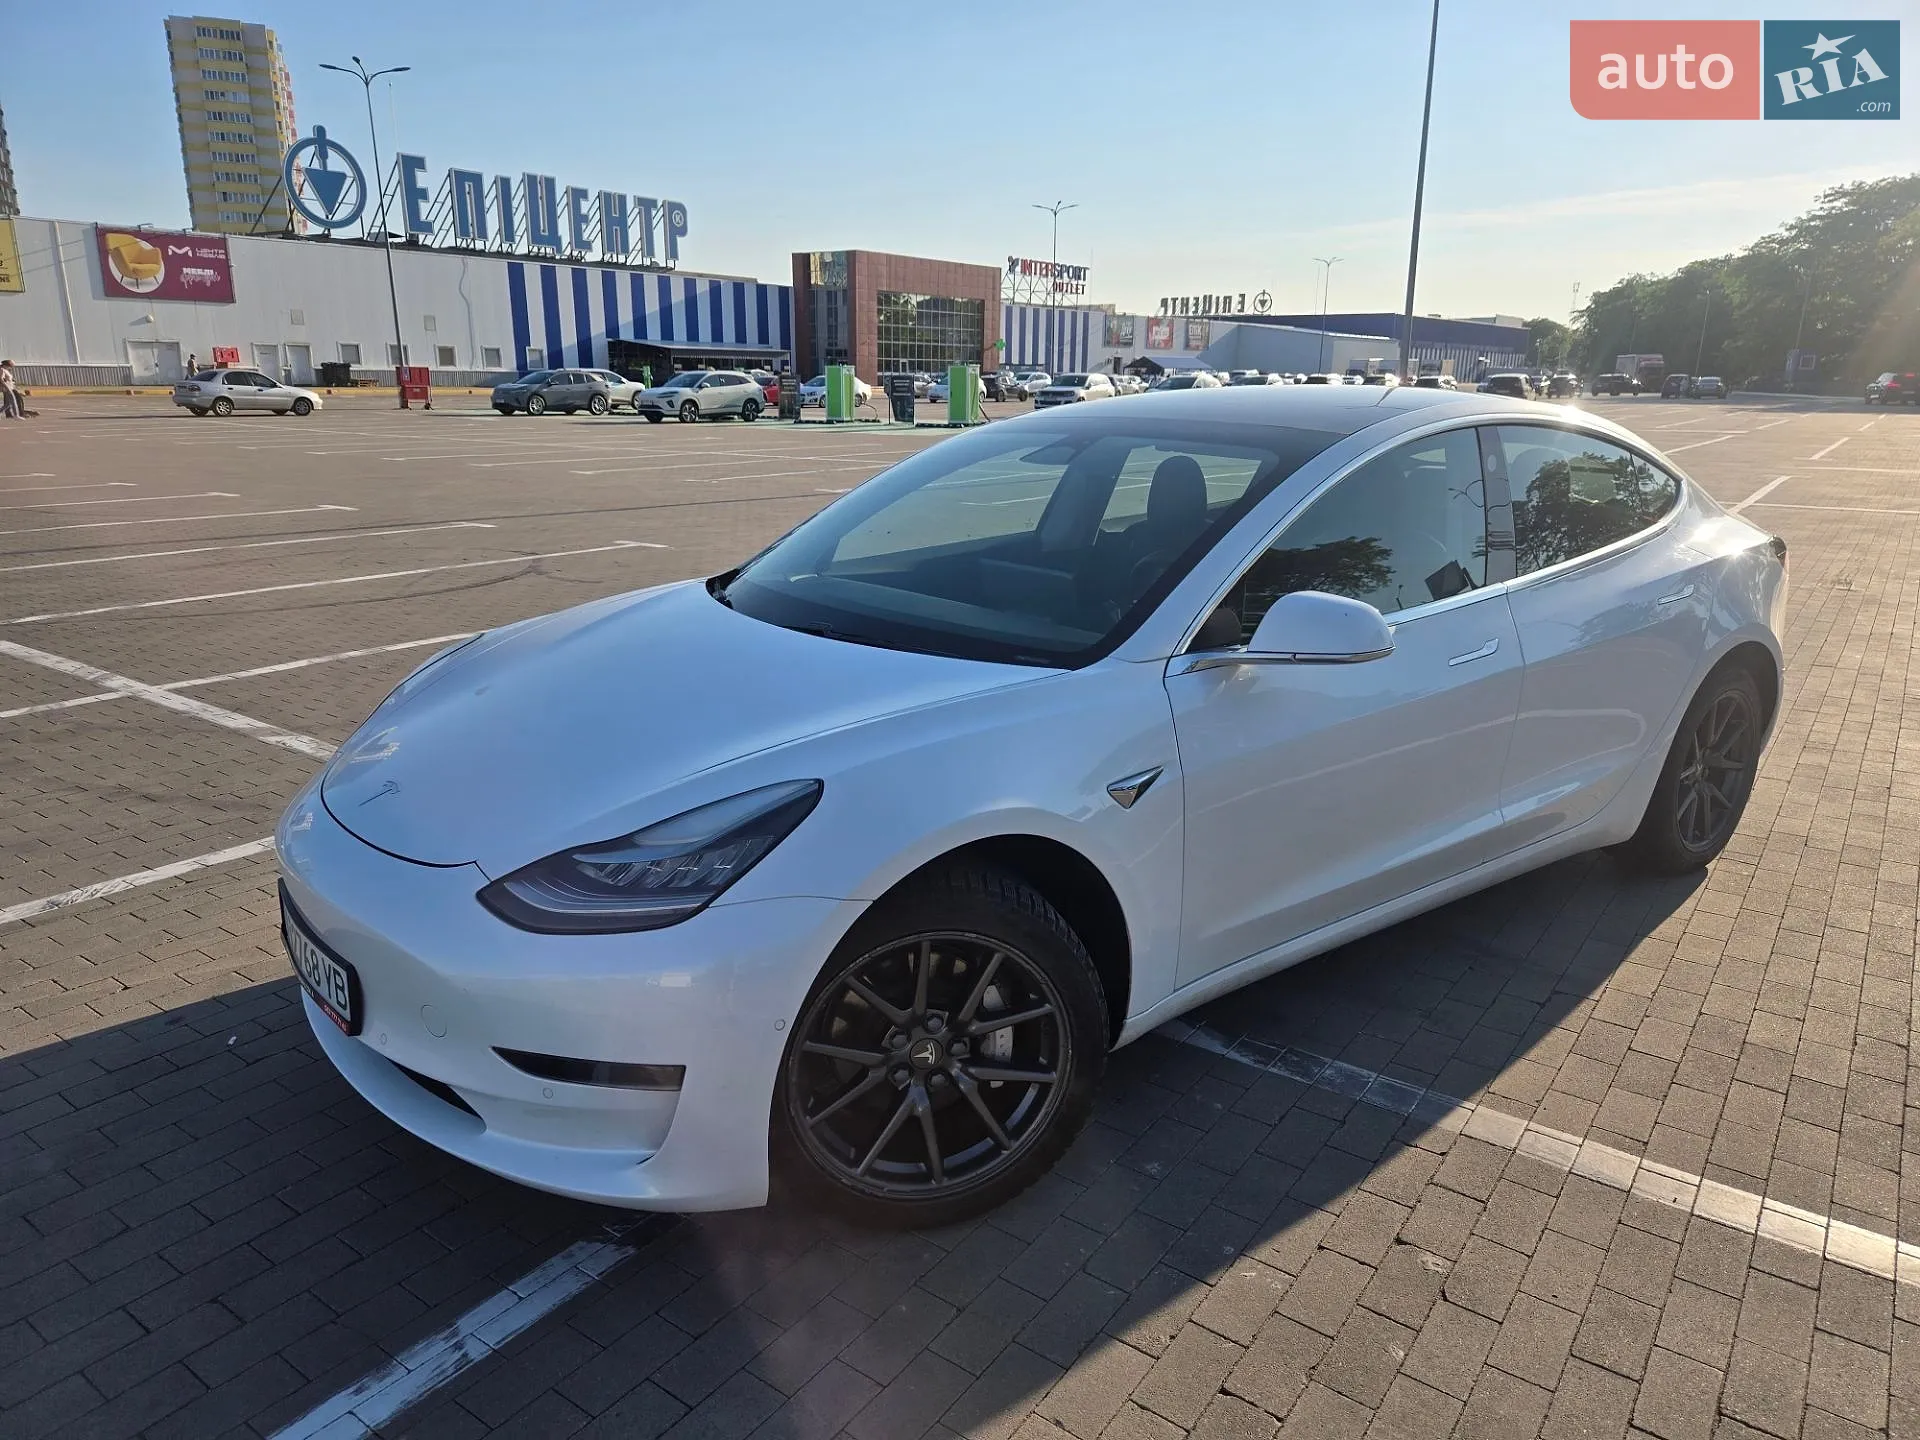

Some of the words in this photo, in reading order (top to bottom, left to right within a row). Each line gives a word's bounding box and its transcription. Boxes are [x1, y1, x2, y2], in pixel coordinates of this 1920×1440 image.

[397, 152, 688, 260] ЕПІЦЕНТР
[1020, 258, 1089, 281] INTERSPORT
[1053, 281, 1086, 295] OUTLET
